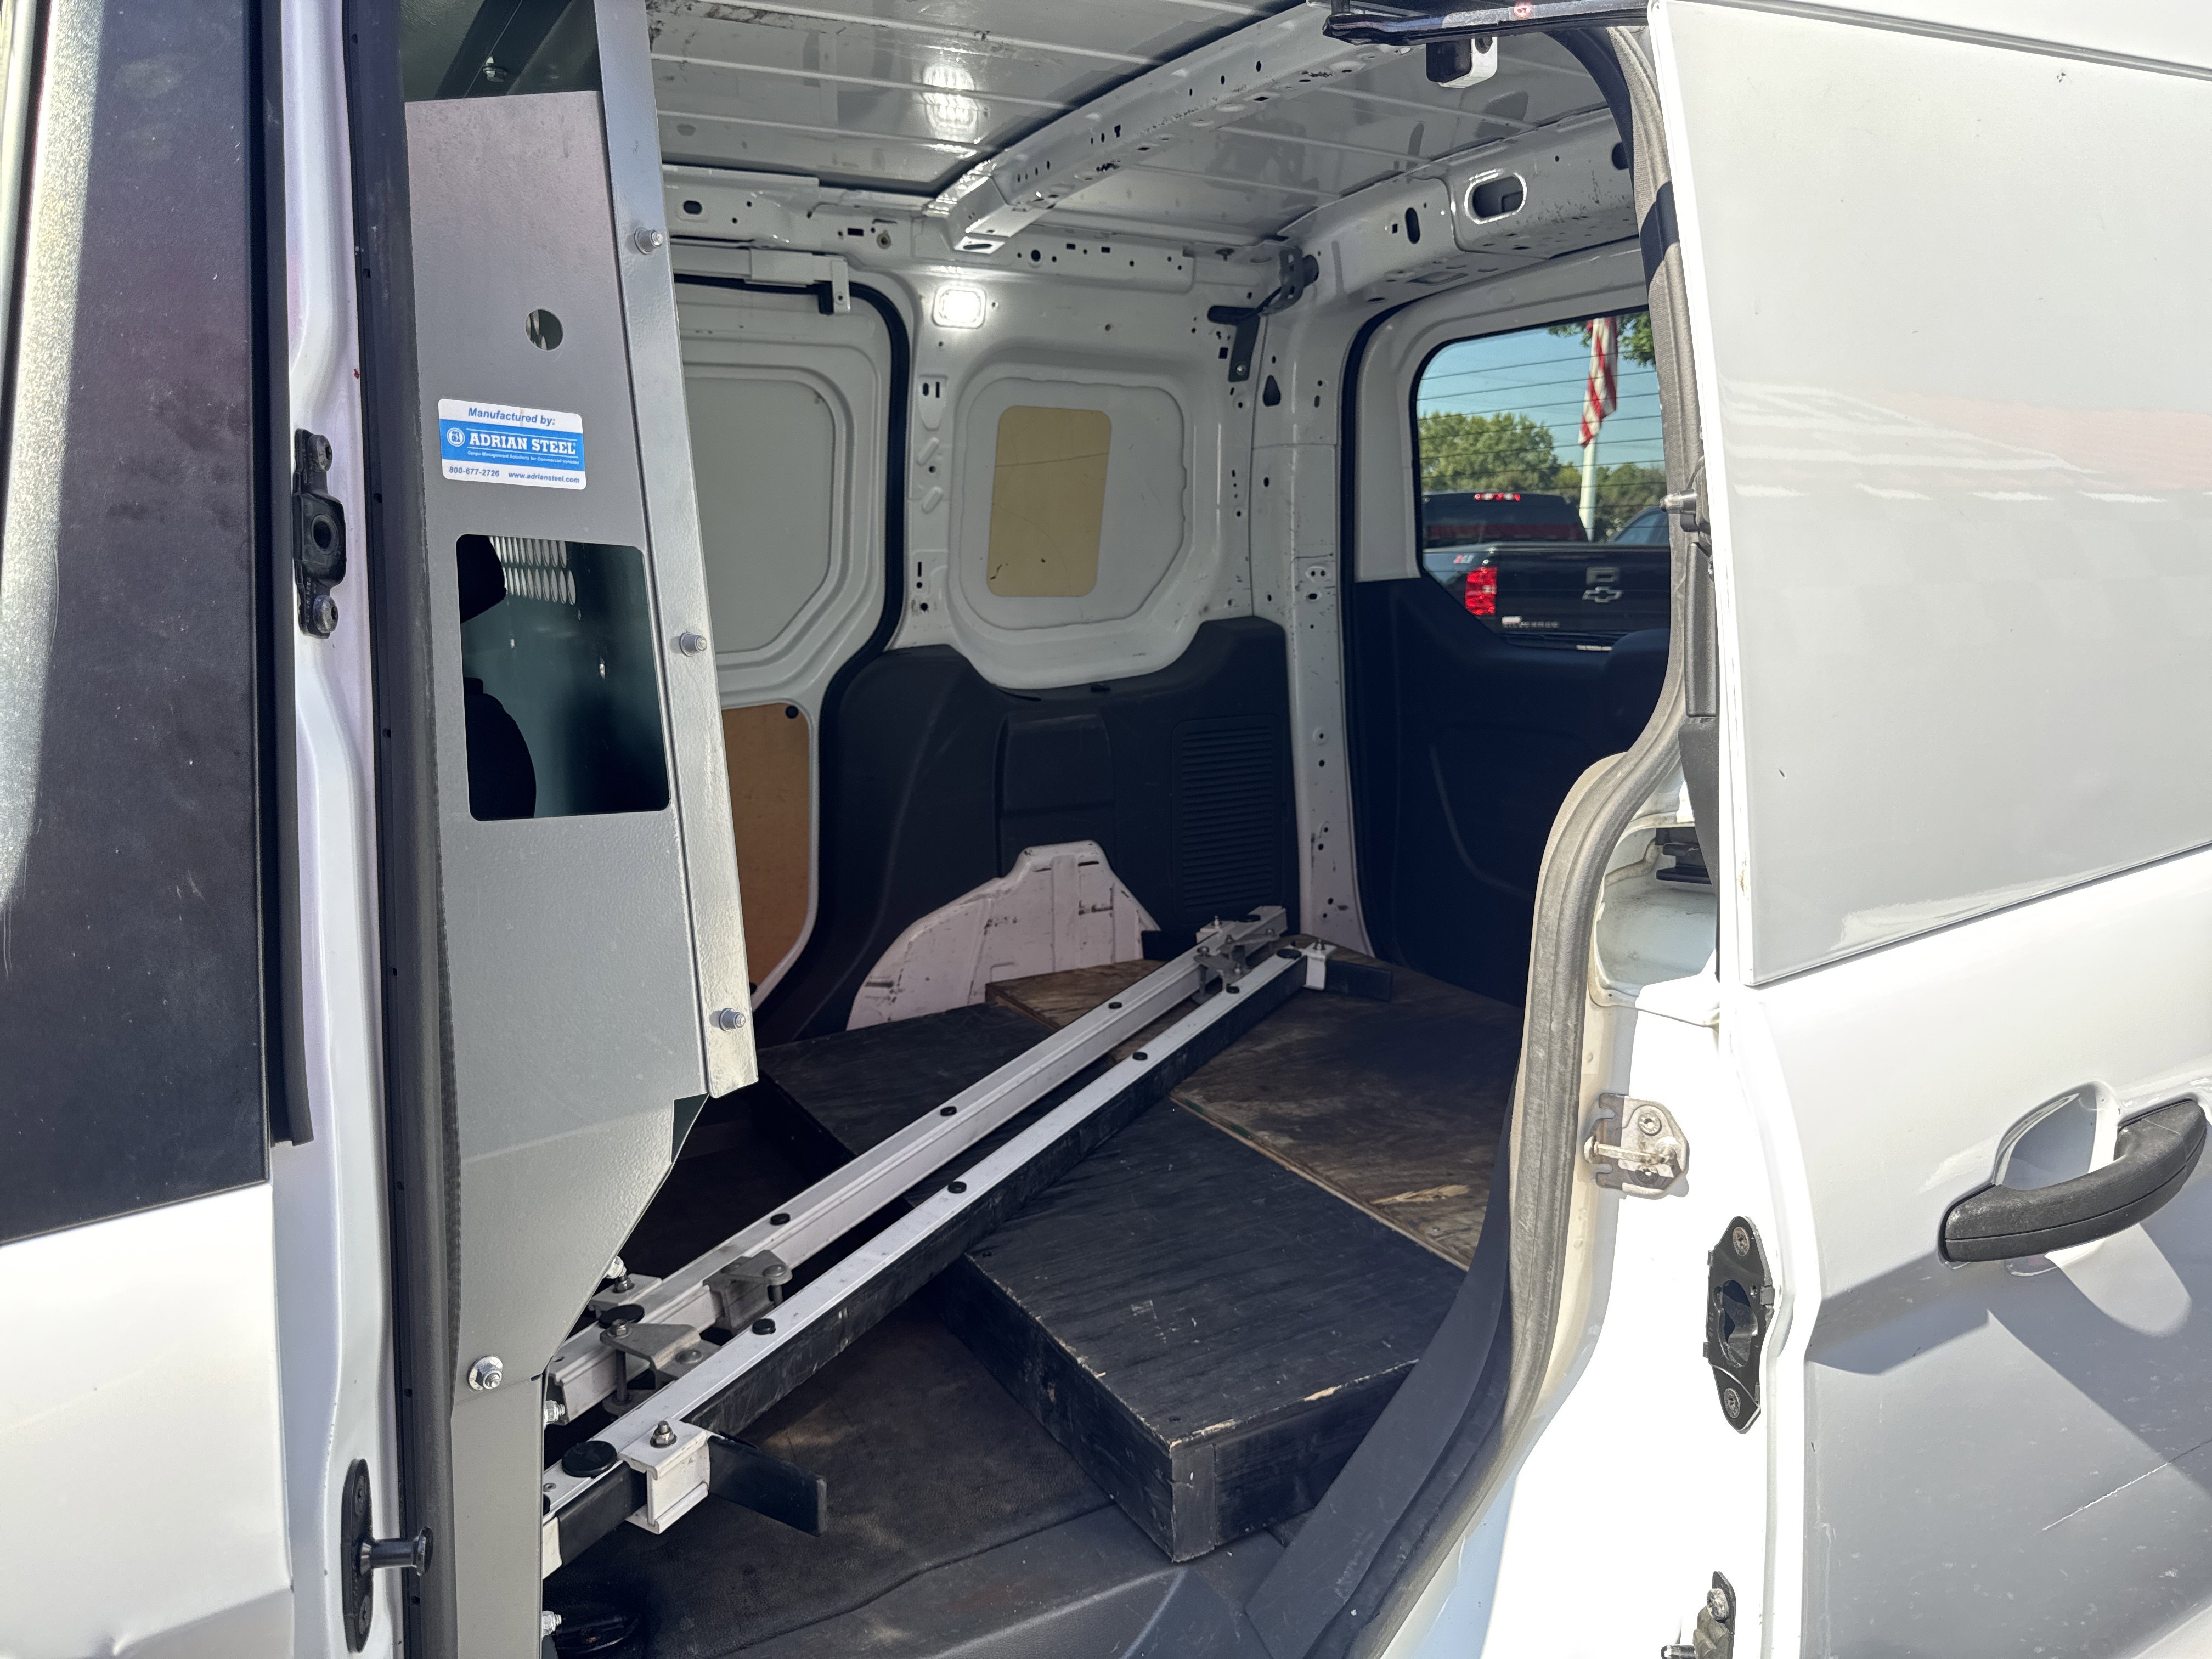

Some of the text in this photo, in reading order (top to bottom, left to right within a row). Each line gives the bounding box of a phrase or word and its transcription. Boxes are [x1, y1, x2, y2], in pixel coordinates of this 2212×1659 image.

[468, 408, 555, 426] Manufactured by:
[470, 433, 527, 450] ADRIAN
[532, 439, 576, 455] STEEL
[449, 466, 580, 483] 800-677-2726 www.adriansteel.com
